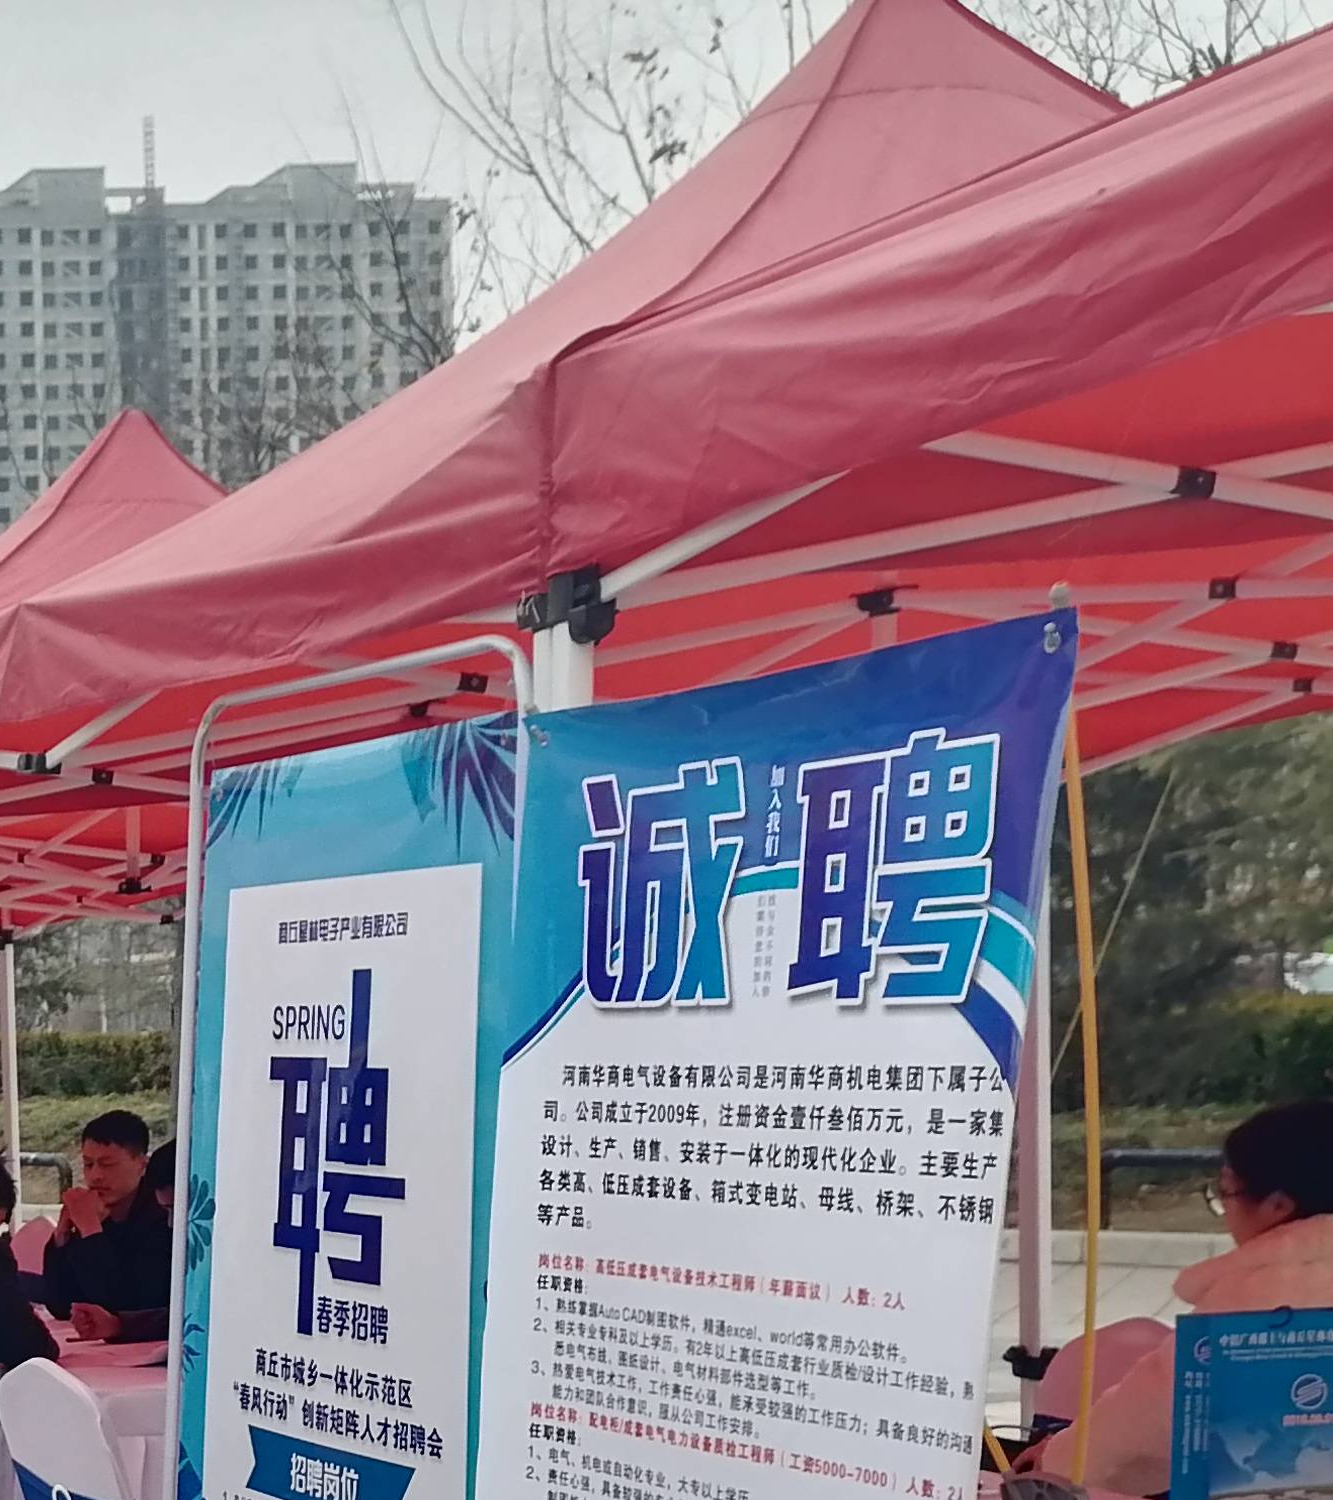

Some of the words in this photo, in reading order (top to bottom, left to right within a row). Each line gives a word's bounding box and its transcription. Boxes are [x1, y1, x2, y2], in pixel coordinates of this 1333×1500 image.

[271, 1003, 345, 1040] SPRING
[270, 968, 406, 1337] 聘
[536, 1202, 592, 1230] 等产品。
[315, 1295, 389, 1345] 春季招聘
[254, 1346, 414, 1410] 商丘市城乡一体化示范区
